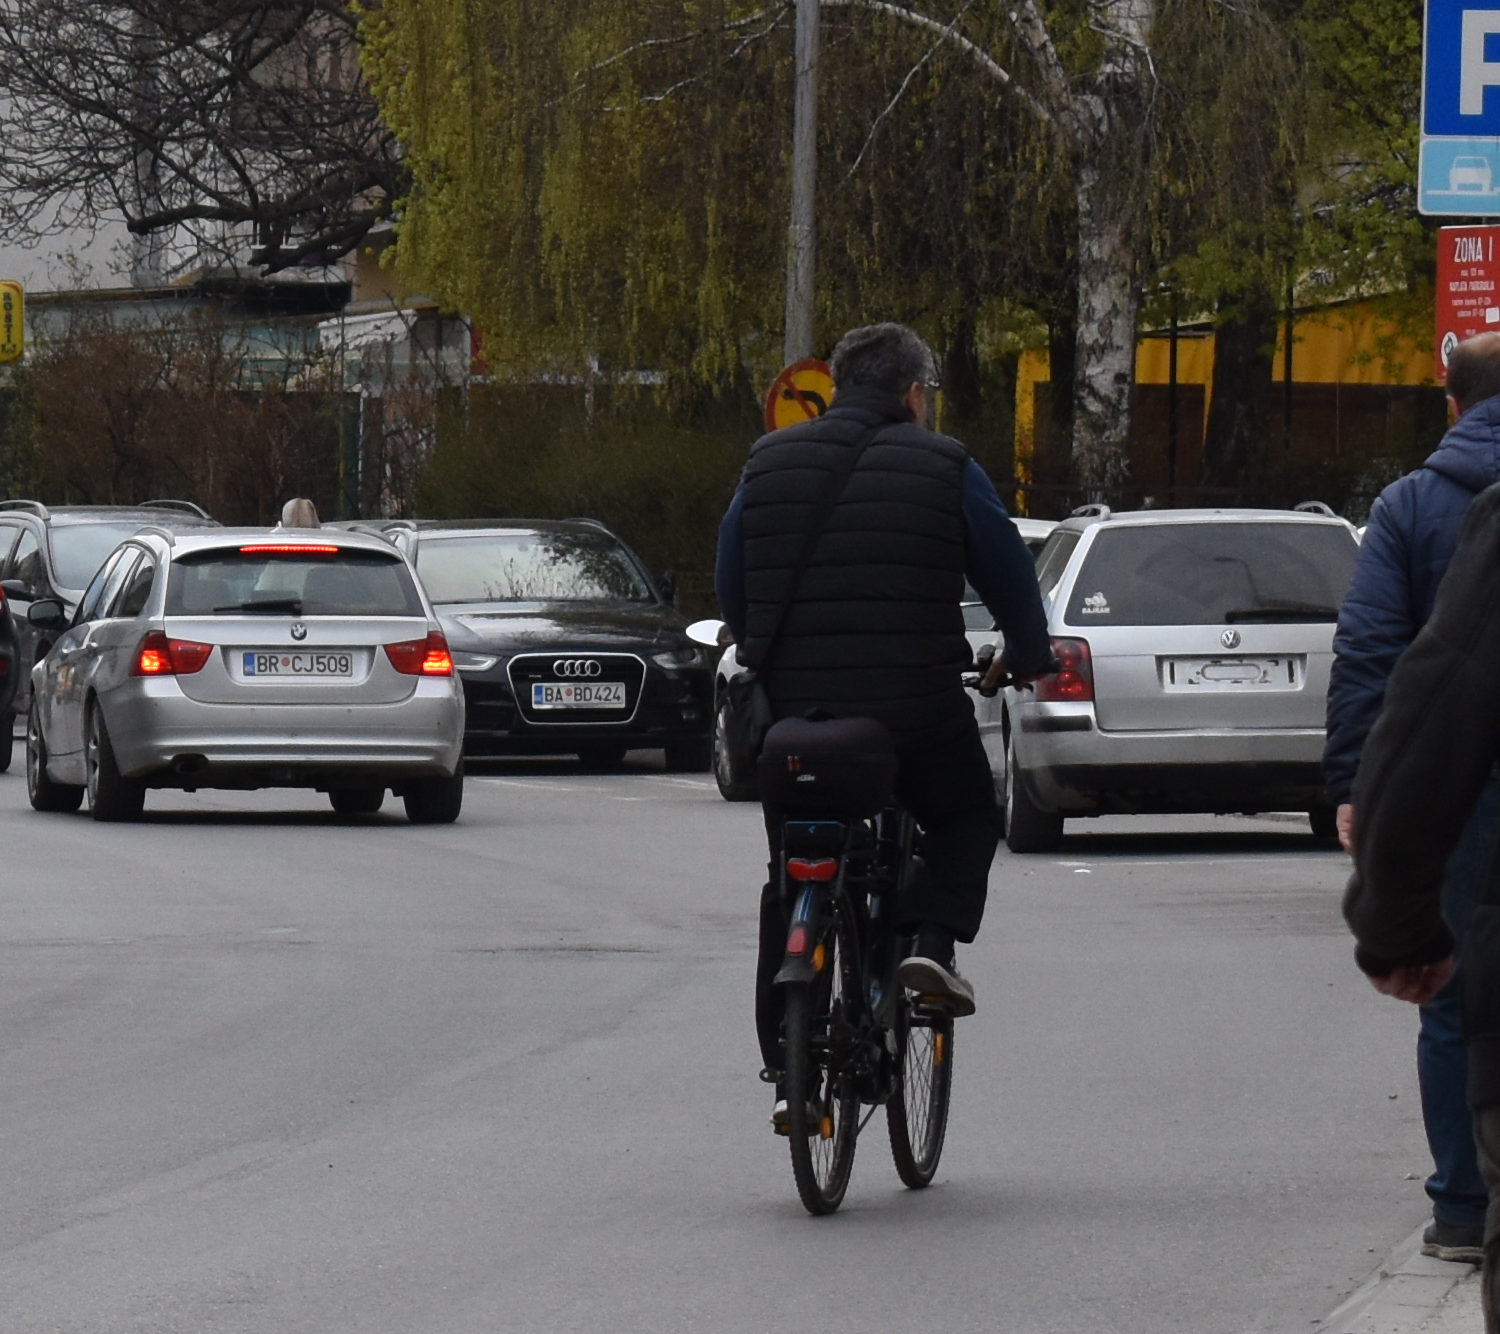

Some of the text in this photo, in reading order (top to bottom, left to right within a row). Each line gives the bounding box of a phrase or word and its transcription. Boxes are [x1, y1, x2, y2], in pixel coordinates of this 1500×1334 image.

[1454, 237, 1483, 263] ZONA
[257, 655, 349, 673] BR CJ509
[544, 686, 621, 702] BA BD424
